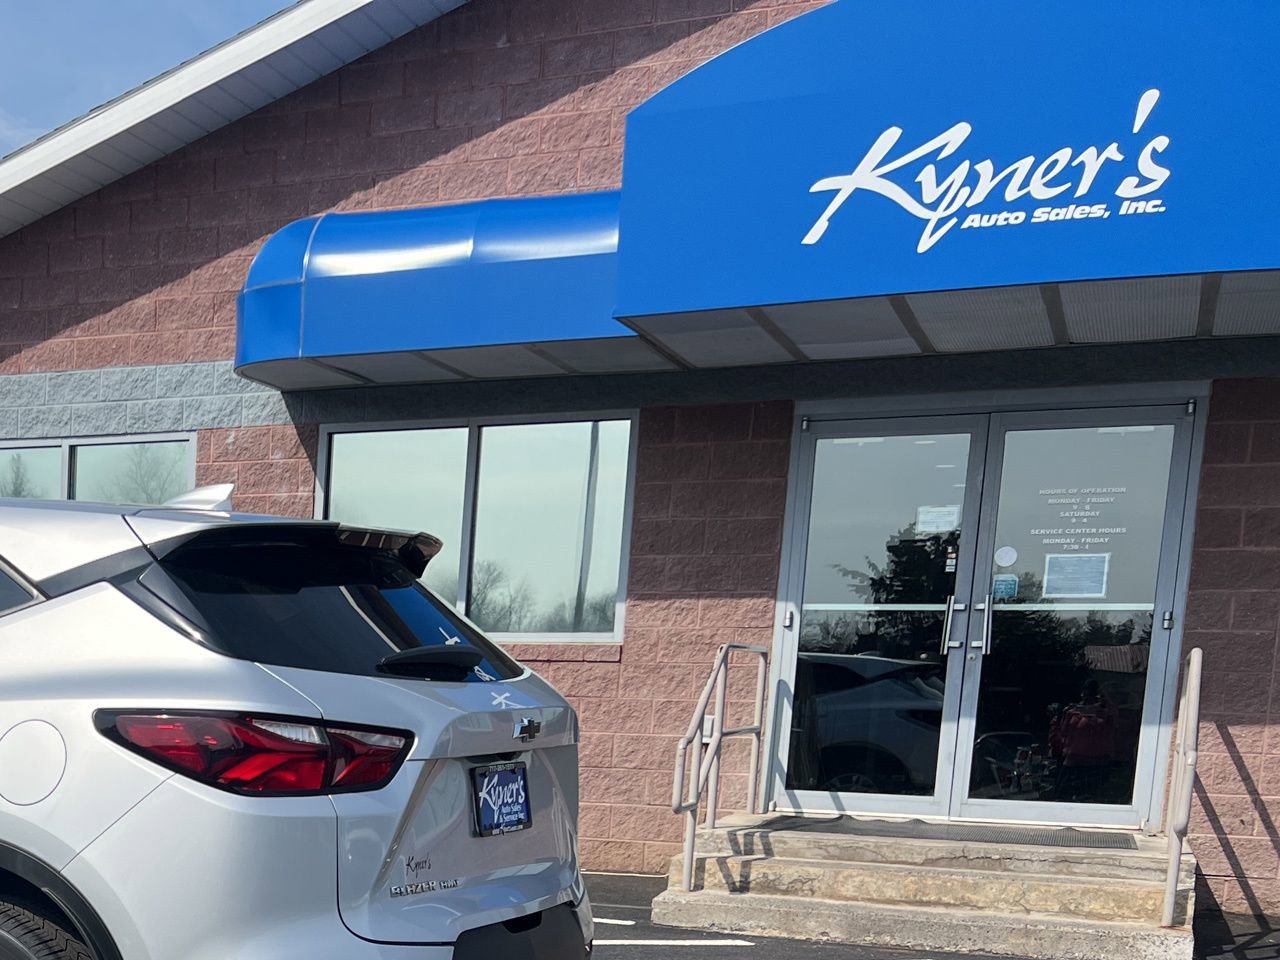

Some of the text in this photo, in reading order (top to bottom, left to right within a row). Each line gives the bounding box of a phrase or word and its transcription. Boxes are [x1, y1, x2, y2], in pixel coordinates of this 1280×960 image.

[801, 88, 1171, 254] Kyner's
[960, 199, 1167, 229] Auto Sales, Inc.
[478, 774, 525, 824] Kyner's
[406, 853, 432, 879] Kyner's
[390, 880, 436, 898] BLAZER
